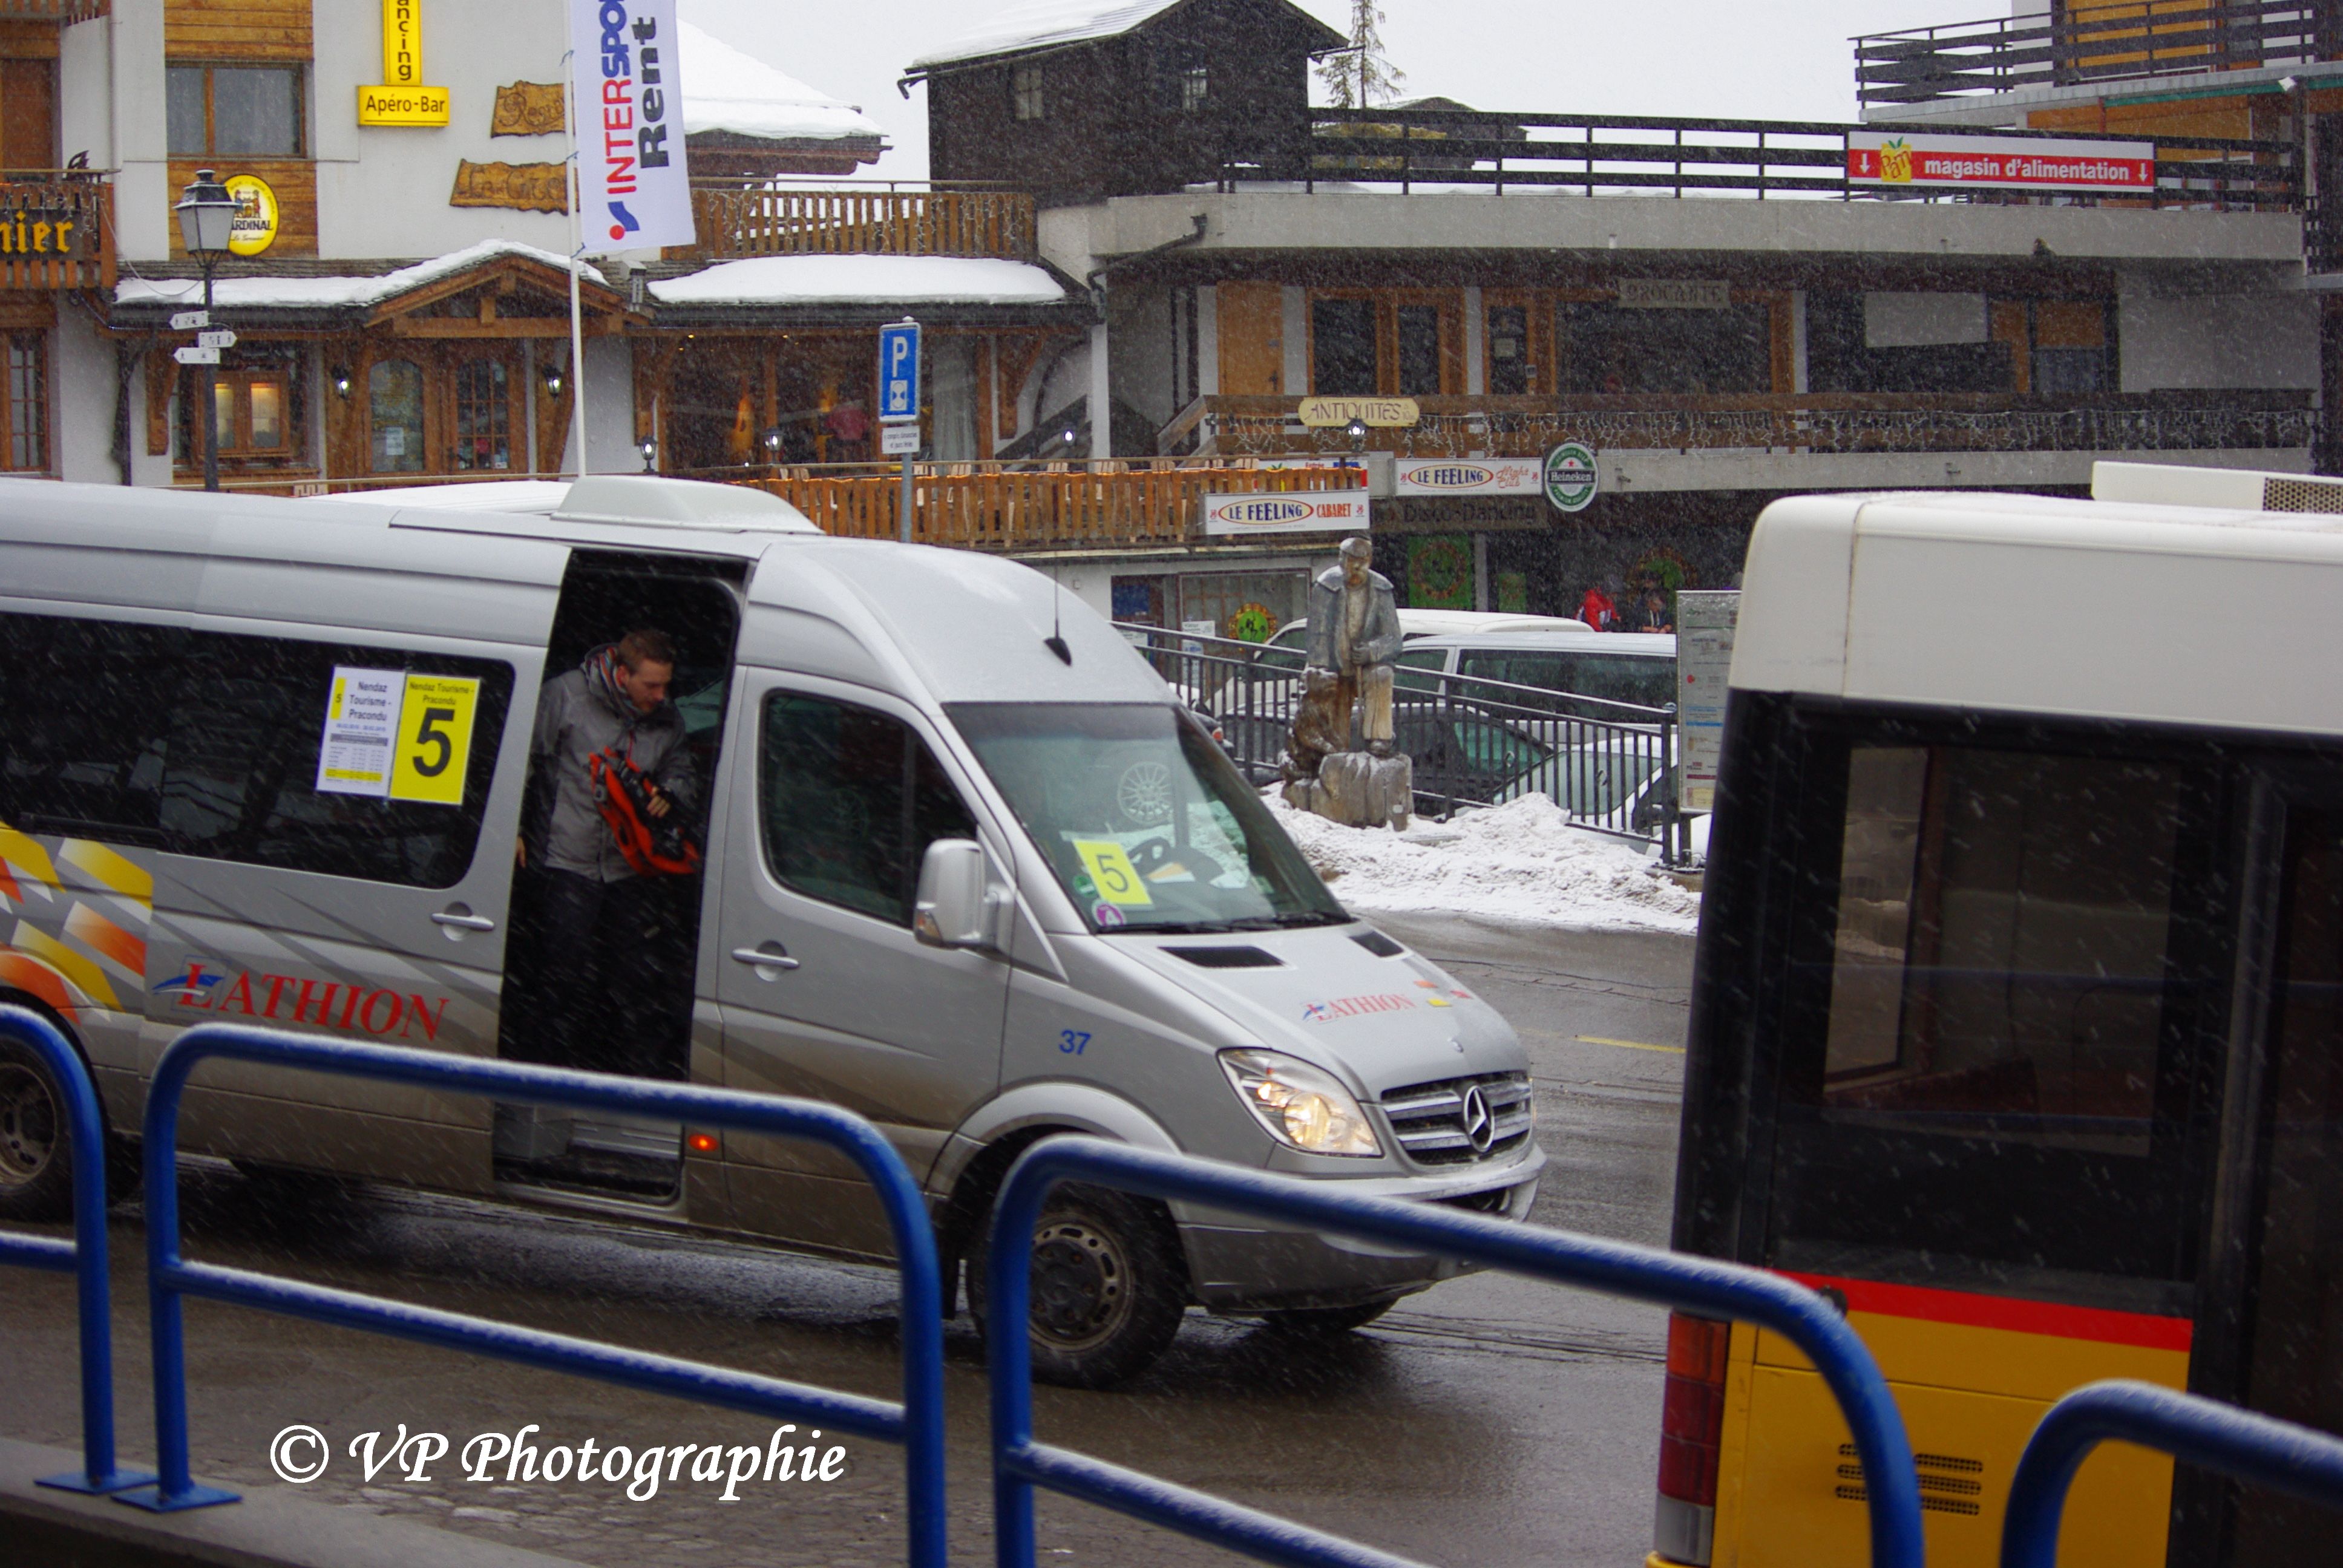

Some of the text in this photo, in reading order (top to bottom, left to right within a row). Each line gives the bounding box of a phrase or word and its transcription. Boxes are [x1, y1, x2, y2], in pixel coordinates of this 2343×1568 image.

[599, 0, 637, 194] INTERSPO
[631, 17, 669, 168] Rent
[365, 94, 445, 116] Apéro-Bar
[1881, 150, 1912, 178] Pam
[1925, 158, 2129, 180] magasin d'alimentation
[231, 219, 273, 230] ARDINAL
[892, 336, 907, 377] P
[1418, 468, 1483, 485] LE FEELING
[1551, 471, 1592, 482] Heineken
[1230, 502, 1351, 521] LE FEELING CABARET
[358, 681, 387, 692] Nendaz
[410, 682, 435, 691] Nendaz
[437, 683, 469, 694] Tourisme
[350, 694, 386, 707] Tourisme
[423, 694, 456, 705] Pracondu
[349, 708, 387, 720] Pracondu
[413, 707, 455, 777] 5
[1096, 854, 1129, 893] 5
[178, 962, 450, 1042] LATHION
[1306, 993, 1417, 1021] LATHION
[1059, 1029, 1091, 1055] 37
